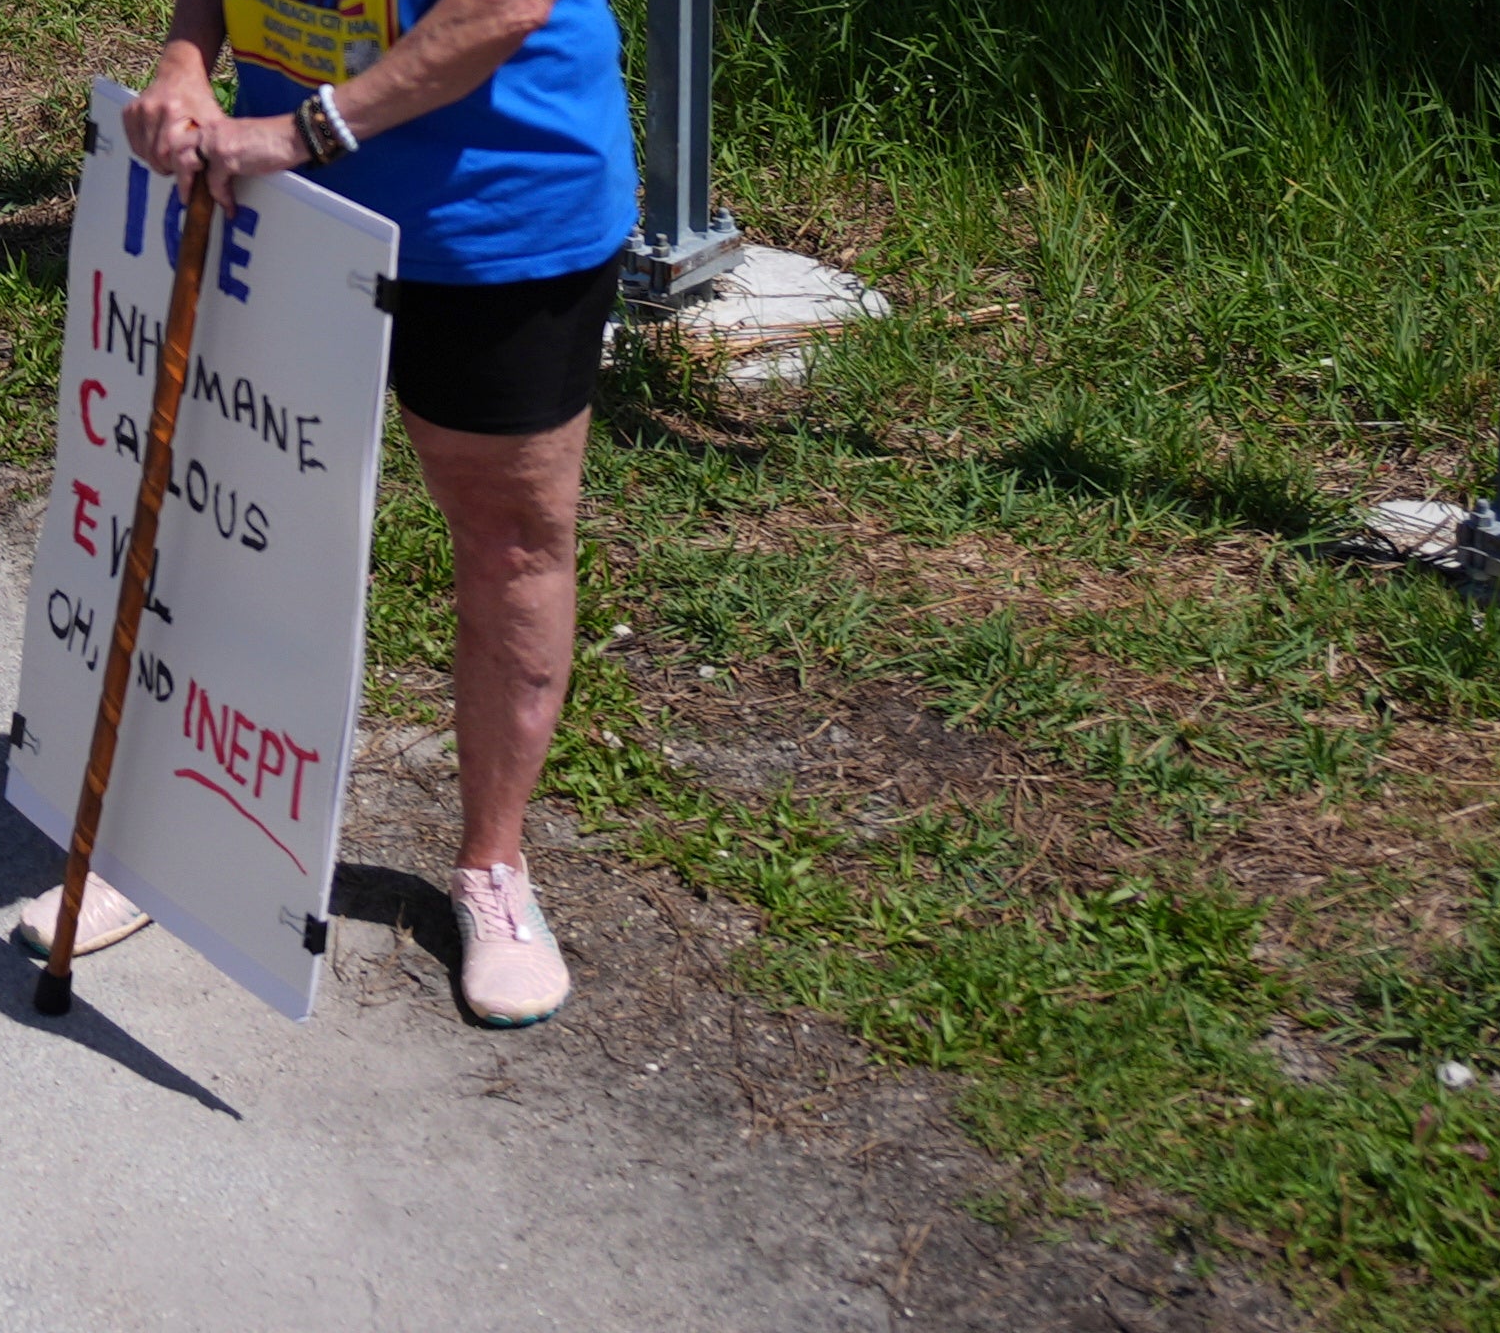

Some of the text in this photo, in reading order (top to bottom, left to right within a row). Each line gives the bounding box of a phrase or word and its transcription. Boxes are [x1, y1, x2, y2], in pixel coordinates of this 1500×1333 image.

[90, 269, 330, 474] INHMANE
[71, 477, 174, 625] EVL
[47, 588, 320, 822] OH, ND INEPT
